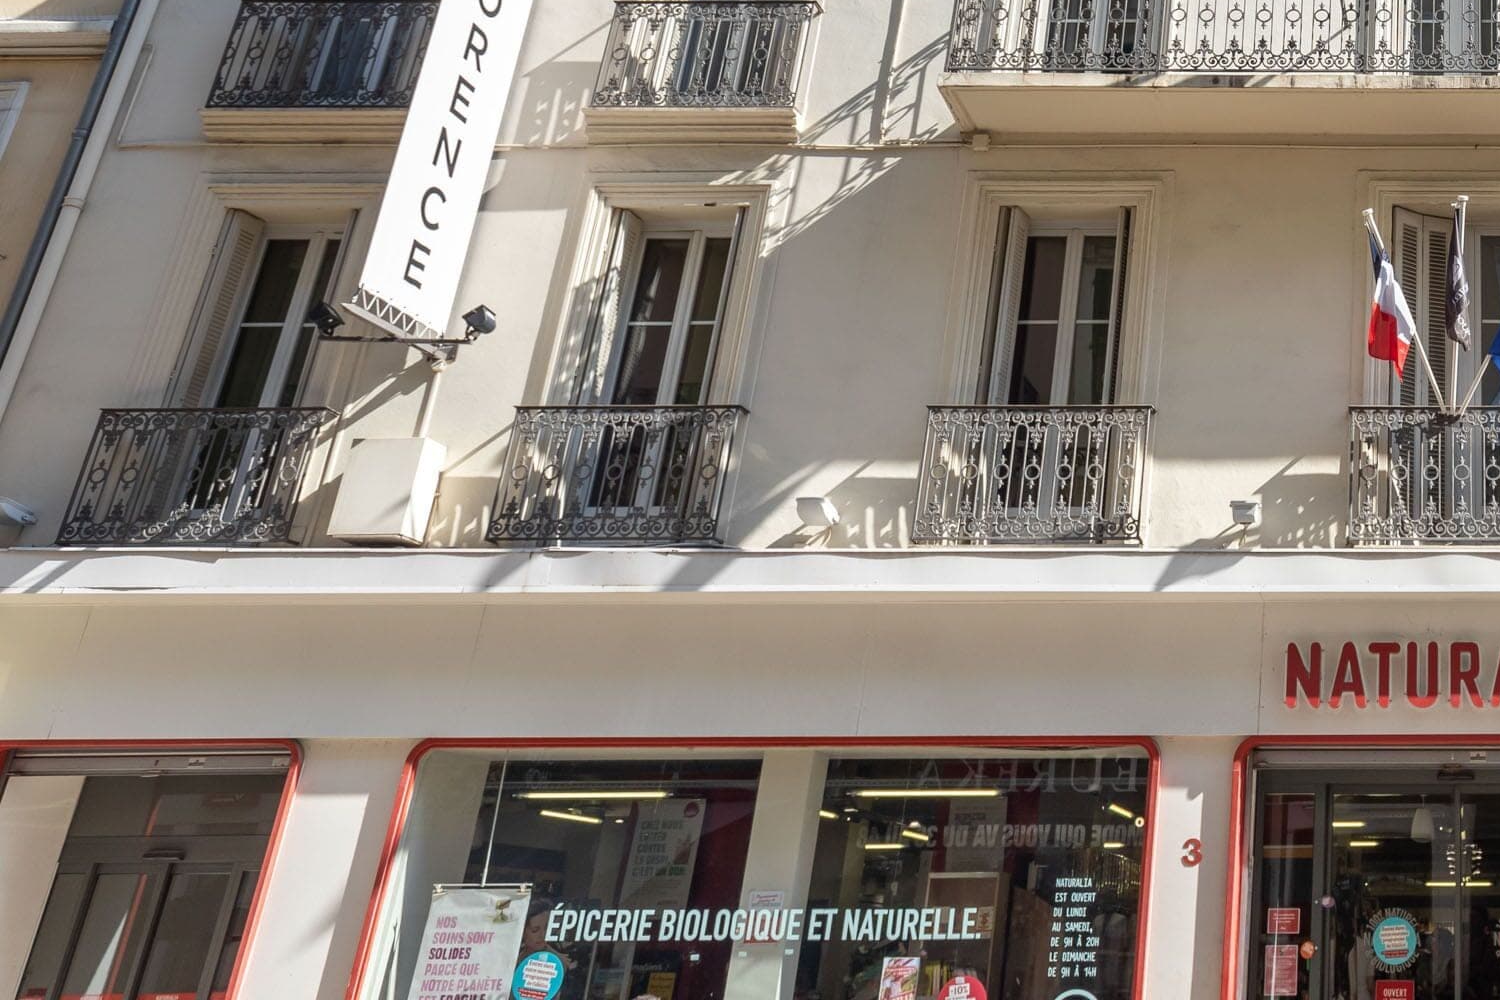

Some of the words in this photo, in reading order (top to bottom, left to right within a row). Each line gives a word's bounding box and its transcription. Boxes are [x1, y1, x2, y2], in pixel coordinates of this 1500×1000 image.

[1181, 837, 1203, 868] 3
[1055, 877, 1093, 888] NATURALIA
[1054, 892, 1068, 903] EST
[1070, 892, 1097, 903] OUVERT
[1052, 907, 1063, 918] DU
[1066, 907, 1088, 918] LUNDI
[436, 915, 458, 929] NOS
[544, 902, 656, 942] ÉPICERIE
[657, 907, 804, 942] BIOLOGIQUE
[806, 907, 839, 942] ET
[840, 906, 982, 942] NATURELLE.
[1051, 921, 1062, 932] AU
[1064, 921, 1094, 934] SAMEDI,
[432, 931, 465, 945] SOINS
[465, 931, 496, 945] SONT
[1050, 936, 1060, 947] DE
[1063, 936, 1073, 949] 9H
[1076, 934, 1082, 947] À
[1085, 936, 1100, 947] 20H
[428, 947, 472, 960] SOLIDES
[1049, 951, 1058, 962] LE
[1062, 951, 1096, 962] DIMANCHE
[424, 963, 459, 976] PARCE
[459, 963, 480, 976] QUE
[1047, 966, 1057, 978] DE
[1060, 966, 1070, 979] 9H
[1074, 964, 1079, 977] À
[1083, 966, 1097, 977] 14H
[420, 979, 456, 992] NOTRE
[1383, 988, 1407, 997] OUVERT
